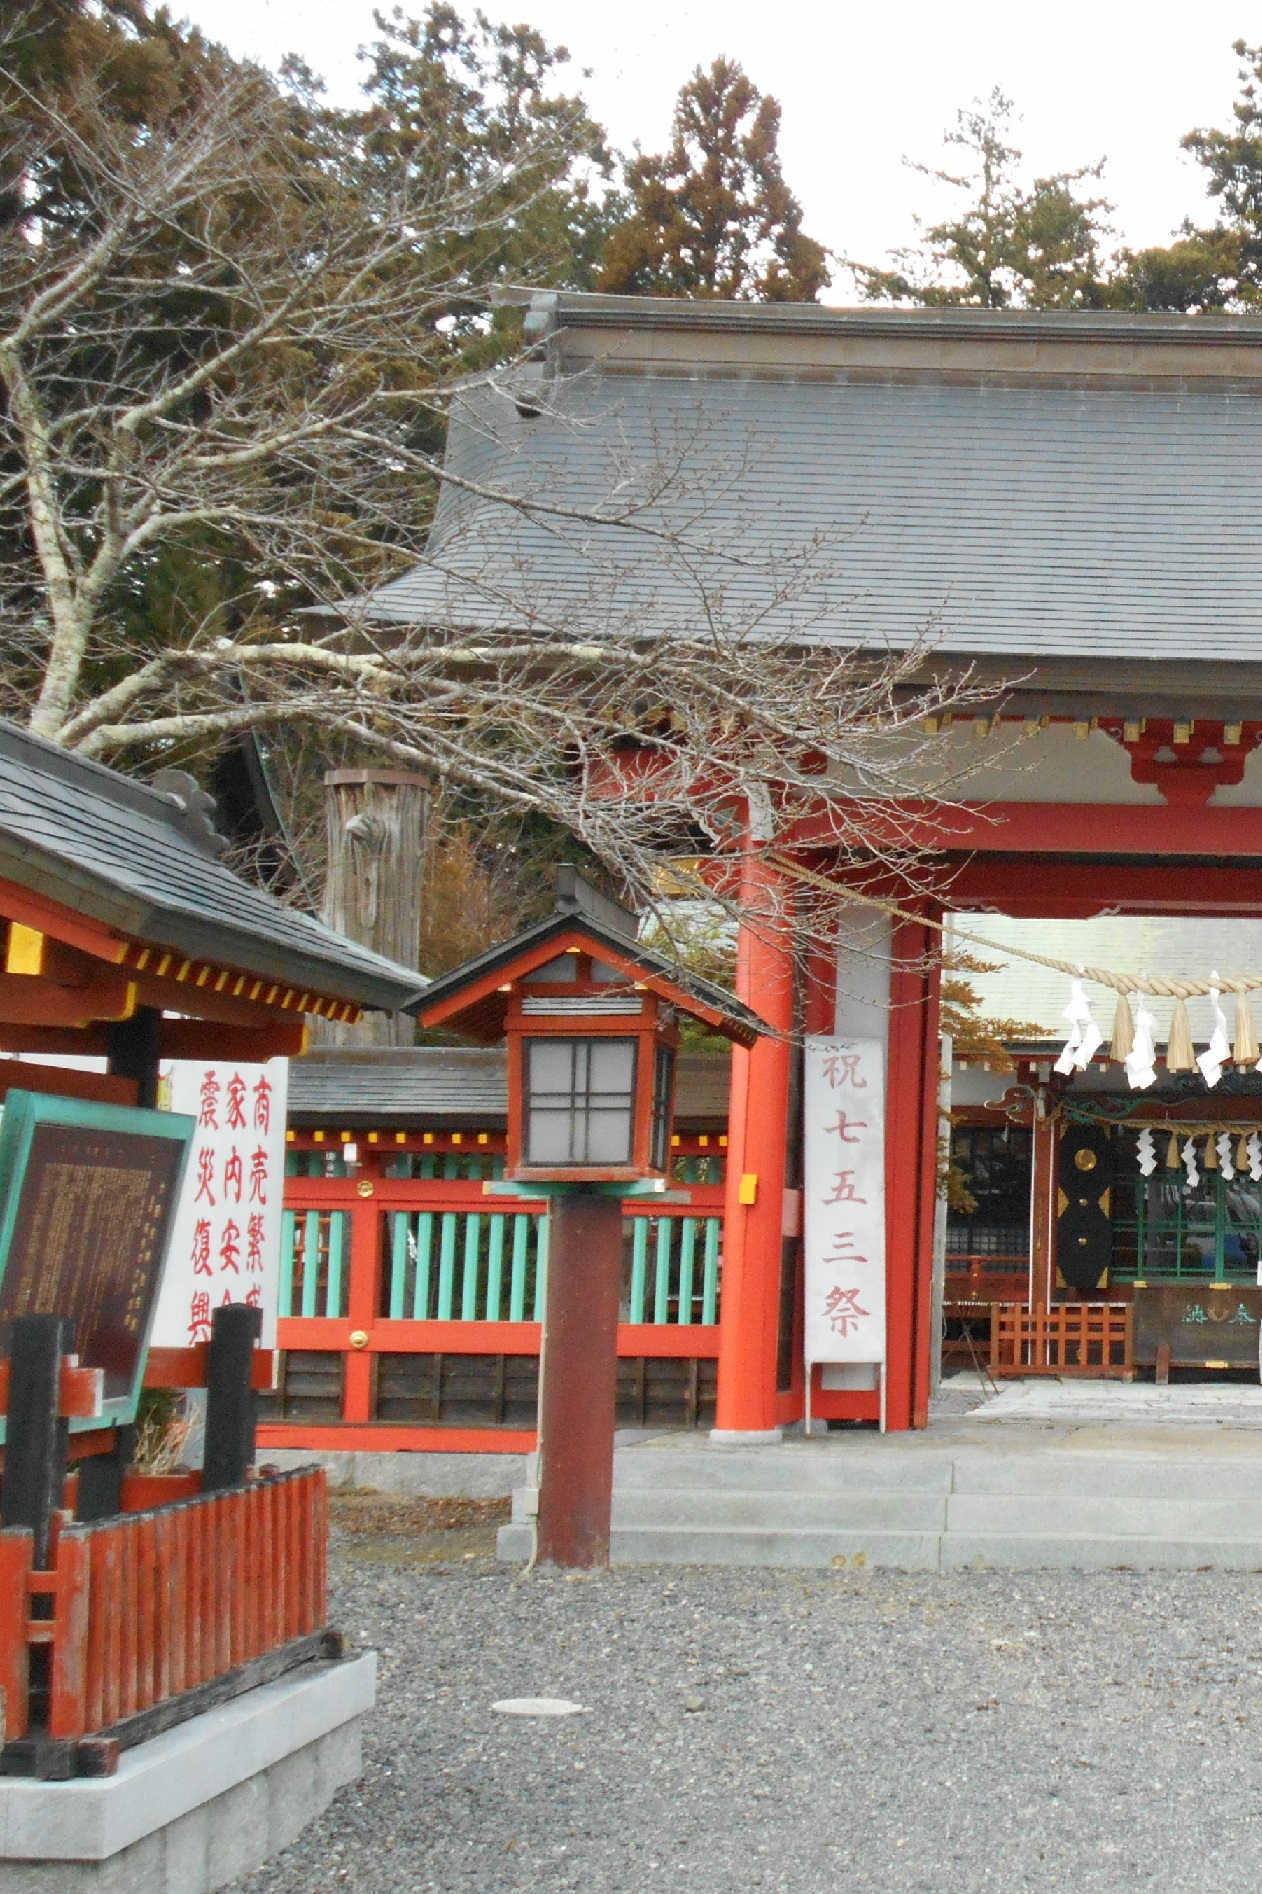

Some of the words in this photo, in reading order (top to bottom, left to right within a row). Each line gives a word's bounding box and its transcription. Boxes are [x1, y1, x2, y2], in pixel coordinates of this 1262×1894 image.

[187, 1069, 221, 1346] 震災復興
[820, 1053, 870, 1338] 祝七五三祭
